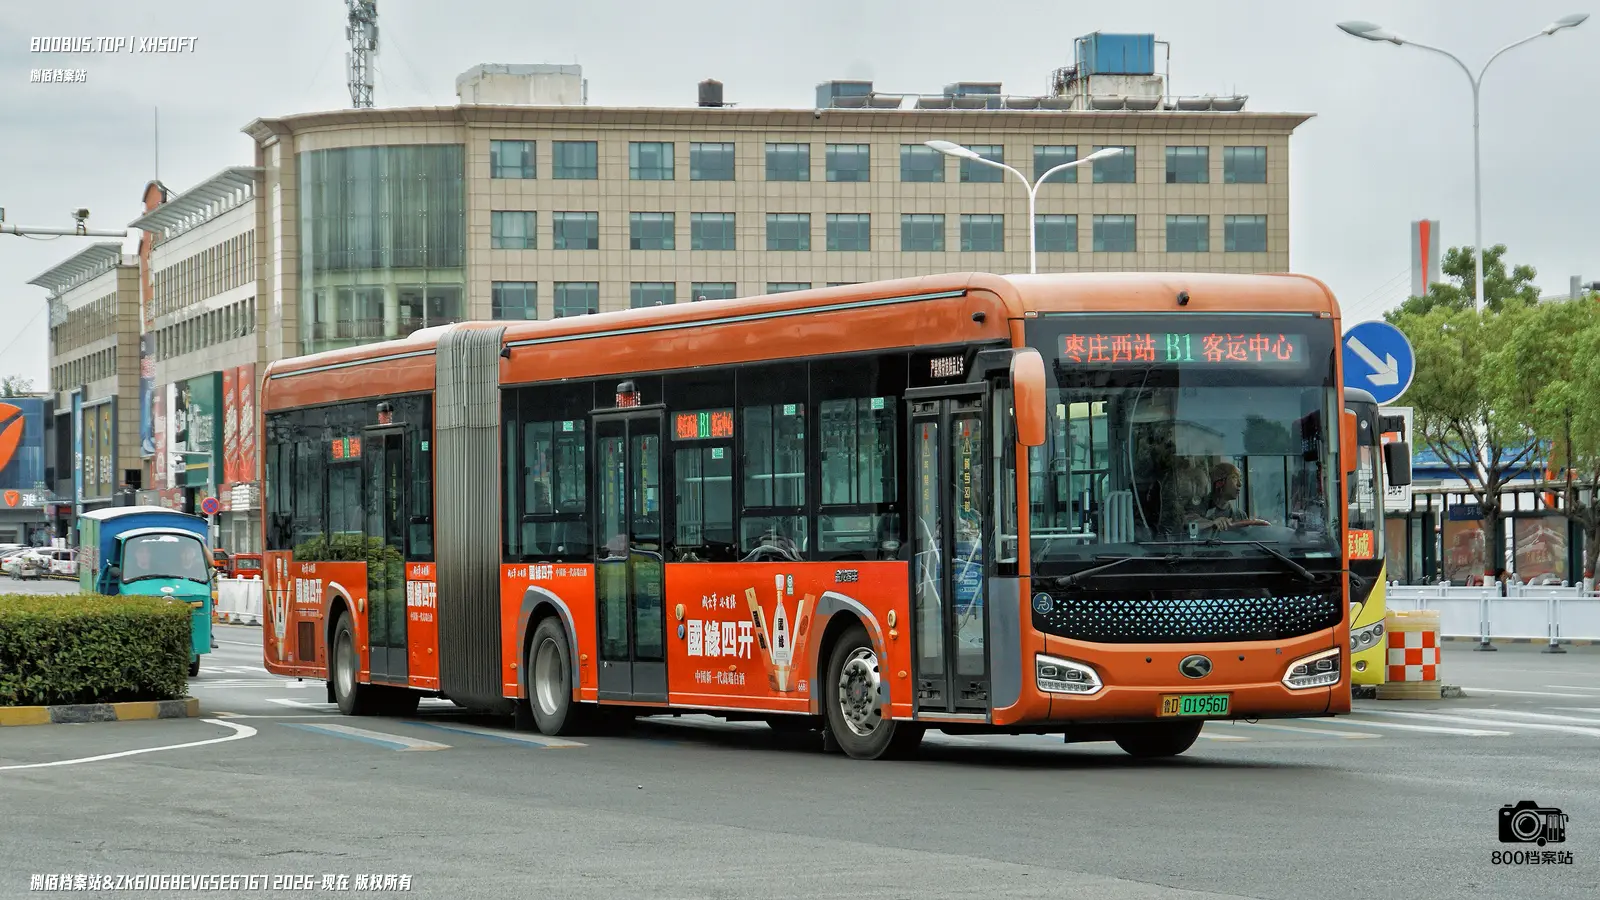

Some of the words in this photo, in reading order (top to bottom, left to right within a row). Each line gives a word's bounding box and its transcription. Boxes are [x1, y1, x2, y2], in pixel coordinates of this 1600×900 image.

[1064, 333, 1155, 363] 枣庄西站
[1165, 333, 1194, 363] B1
[1202, 333, 1293, 363] 客运中心
[699, 412, 710, 438] B1
